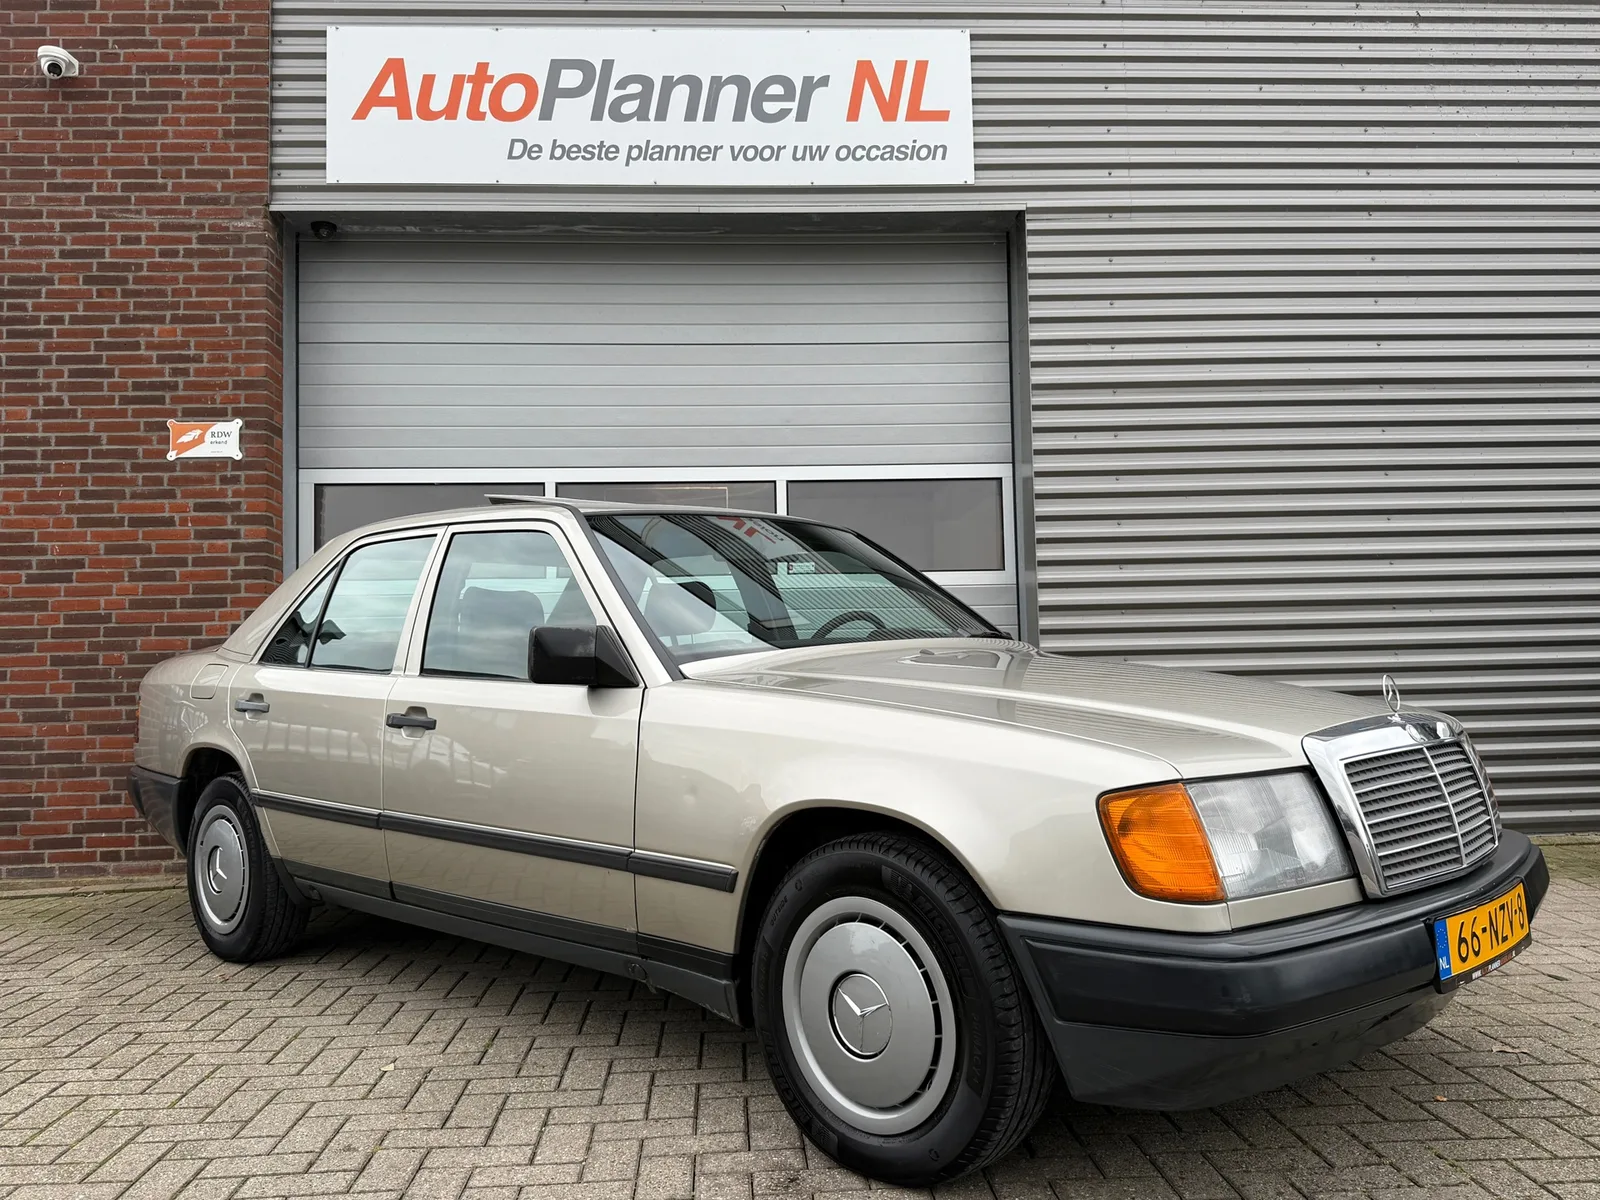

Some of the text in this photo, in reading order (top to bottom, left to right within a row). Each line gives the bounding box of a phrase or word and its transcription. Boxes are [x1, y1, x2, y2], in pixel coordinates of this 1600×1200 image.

[352, 58, 950, 123] AutoPlanner NL
[507, 139, 947, 167] De beste planner voor uw occasion
[770, 895, 788, 927] OUTSIDE
[1457, 892, 1525, 963] 66-NZV-8
[1439, 956, 1450, 970] NL
